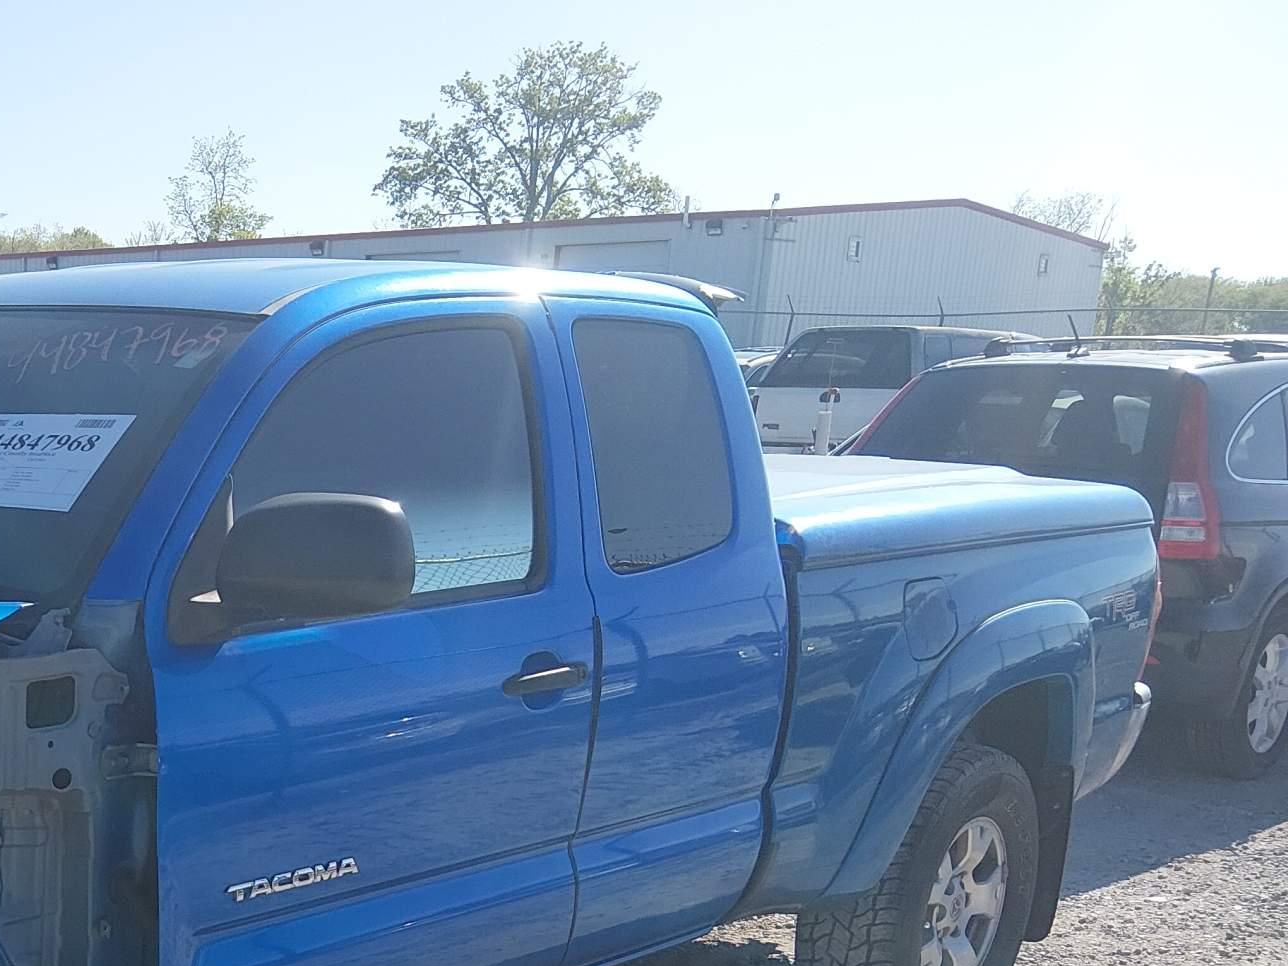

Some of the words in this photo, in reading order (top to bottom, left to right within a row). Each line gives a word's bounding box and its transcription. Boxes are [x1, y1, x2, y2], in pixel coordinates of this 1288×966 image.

[8, 321, 228, 383] 44847968
[1102, 589, 1137, 622] TRD
[226, 856, 360, 902] TACOMA
